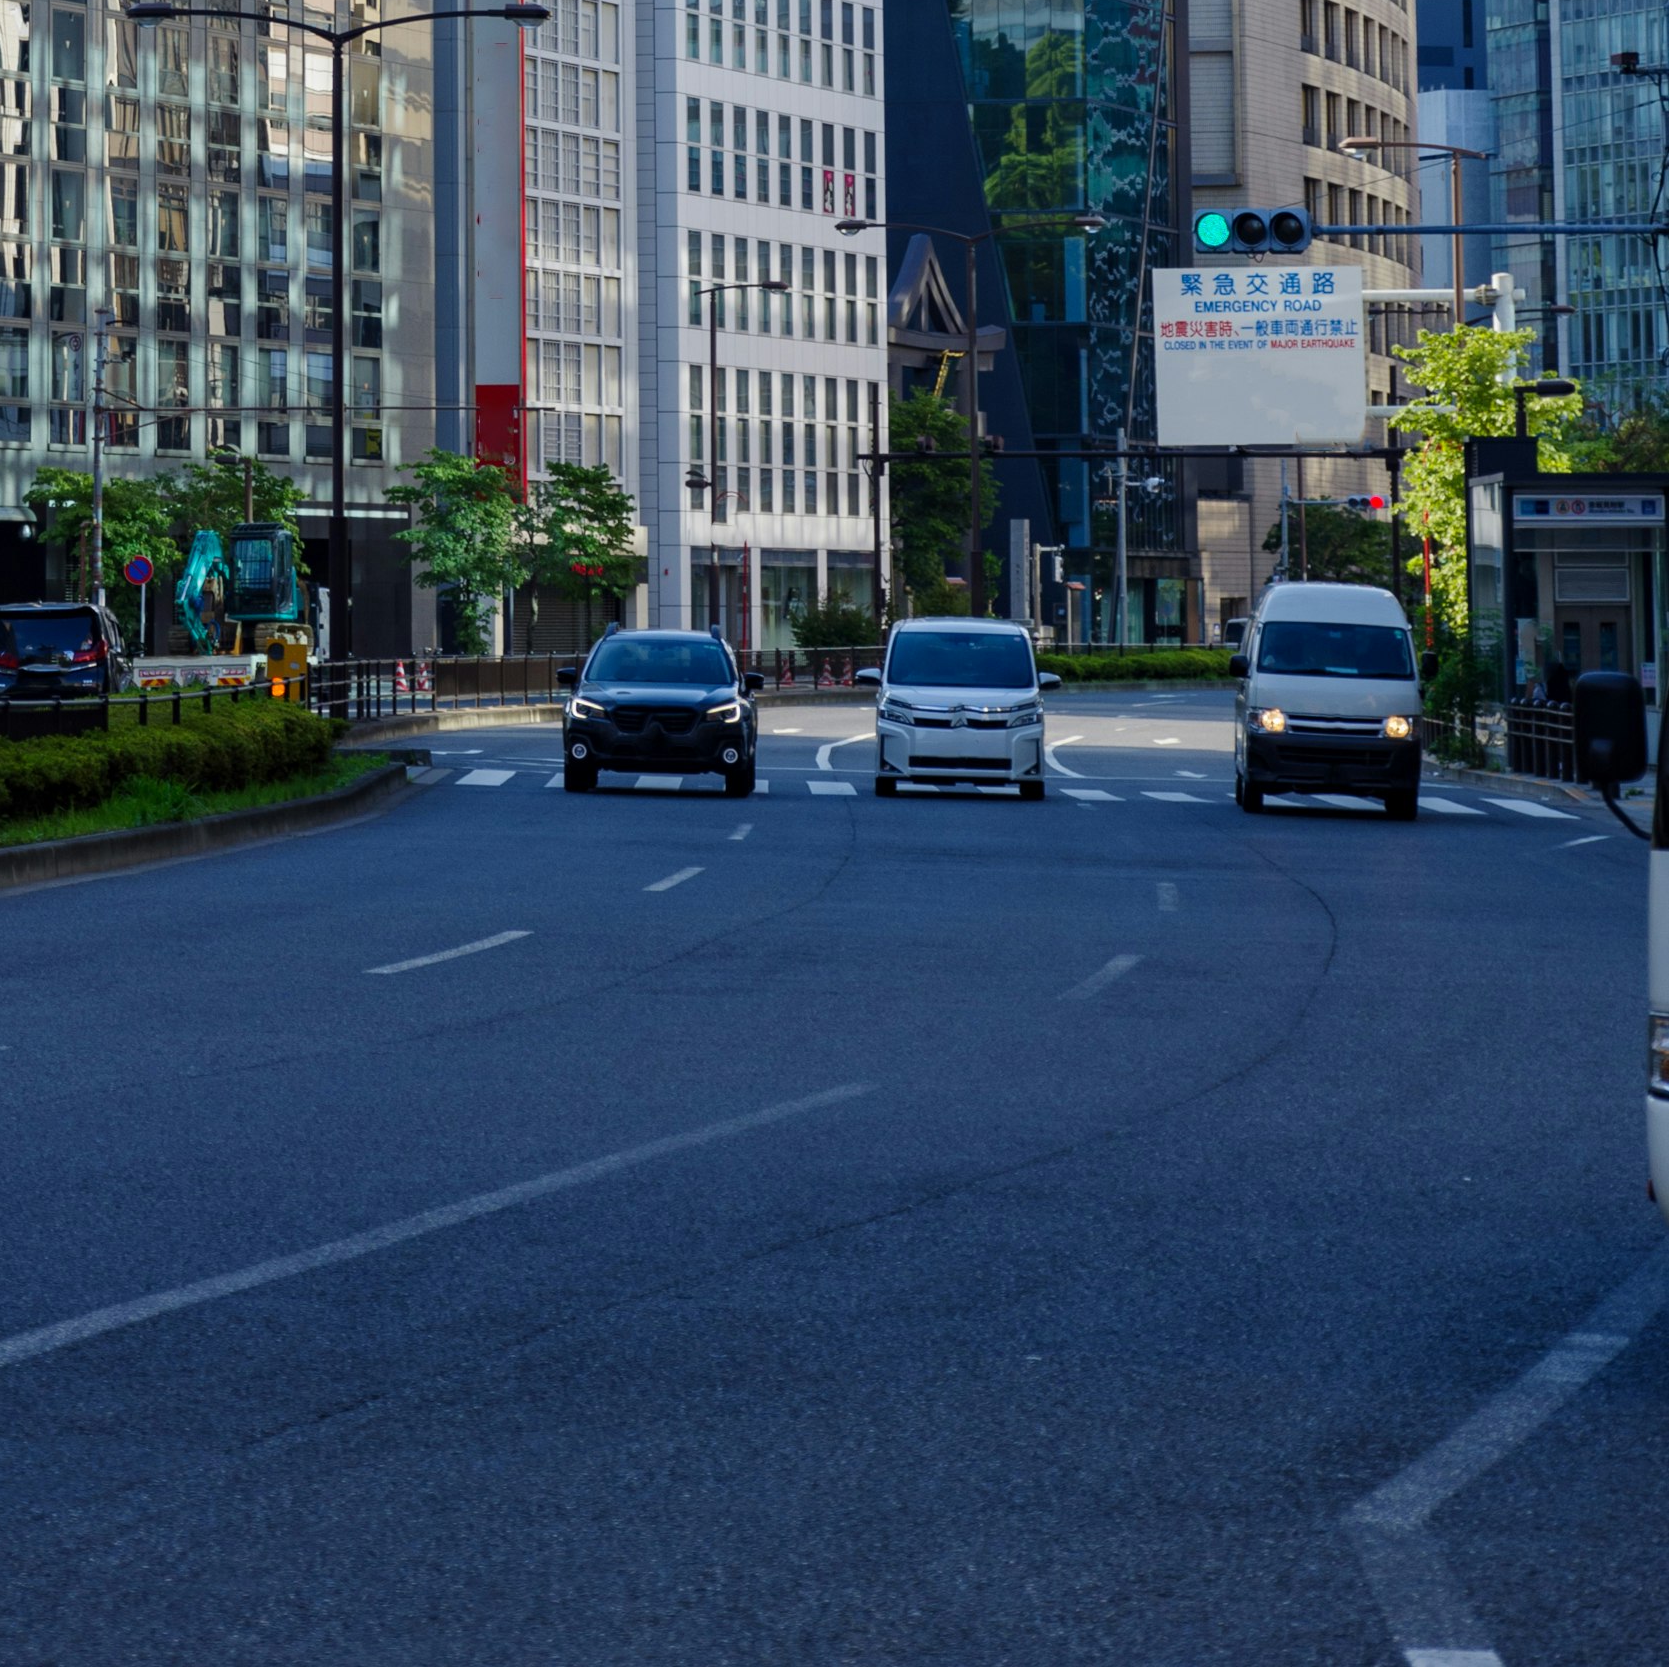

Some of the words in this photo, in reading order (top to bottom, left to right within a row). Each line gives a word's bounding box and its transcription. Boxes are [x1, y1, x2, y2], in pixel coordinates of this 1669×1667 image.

[1180, 272, 1335, 297] 緊急交通路
[1195, 300, 1278, 313] EMERGENCY
[1284, 299, 1322, 312] ROAD
[1160, 319, 1359, 339] 地震災害時、一般車両通行禁止
[1164, 341, 1196, 351] CLOSED
[1199, 341, 1207, 350] IN
[1209, 340, 1226, 350] THE
[1228, 340, 1254, 349] EVENT
[1257, 340, 1268, 349] OF
[1271, 339, 1299, 349] MAJOR
[1301, 339, 1356, 349] EARTHQUAKE
